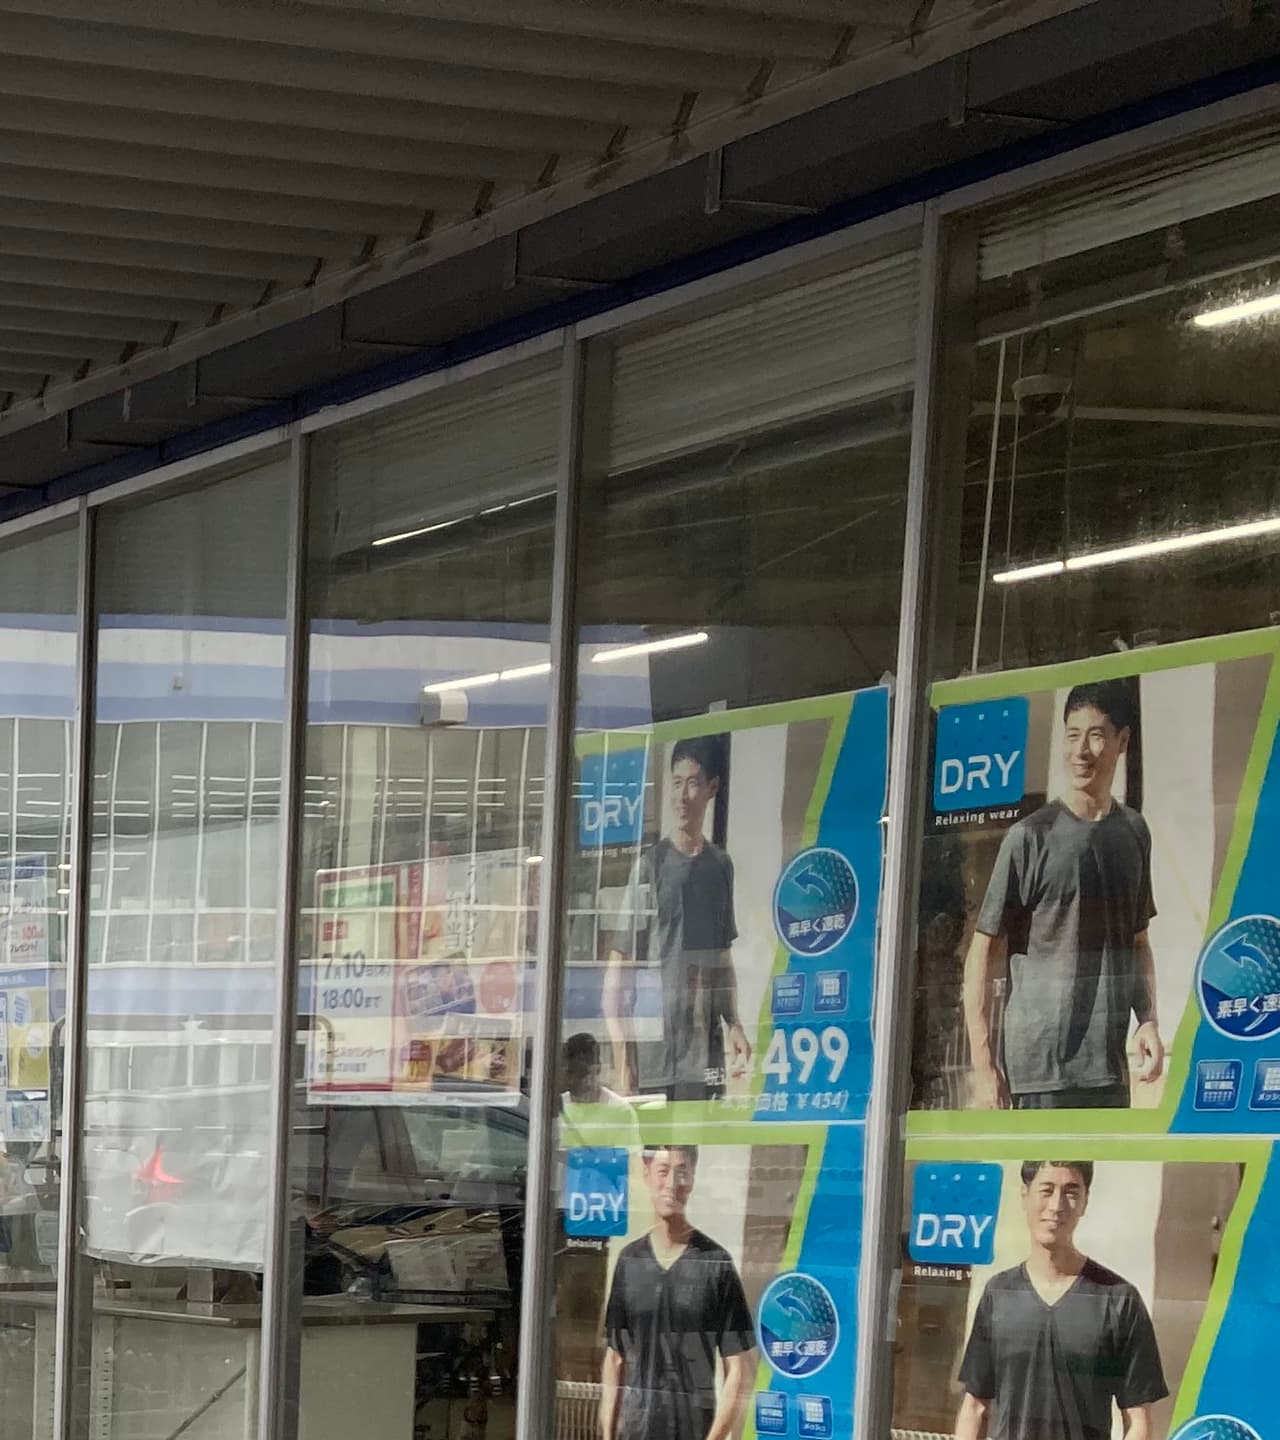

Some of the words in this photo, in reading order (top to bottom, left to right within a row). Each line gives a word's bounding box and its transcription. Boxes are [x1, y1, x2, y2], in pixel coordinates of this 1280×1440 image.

[940, 750, 1020, 794] DRY
[584, 795, 642, 832] DRY
[935, 813, 985, 826] Relaxing
[990, 808, 1020, 819] wear
[789, 913, 846, 938] 素早く速乾
[569, 1191, 625, 1222] DRY
[915, 1213, 993, 1249] DRY
[913, 1265, 962, 1280] Relaxing
[771, 1340, 828, 1357] 素早く速乾
